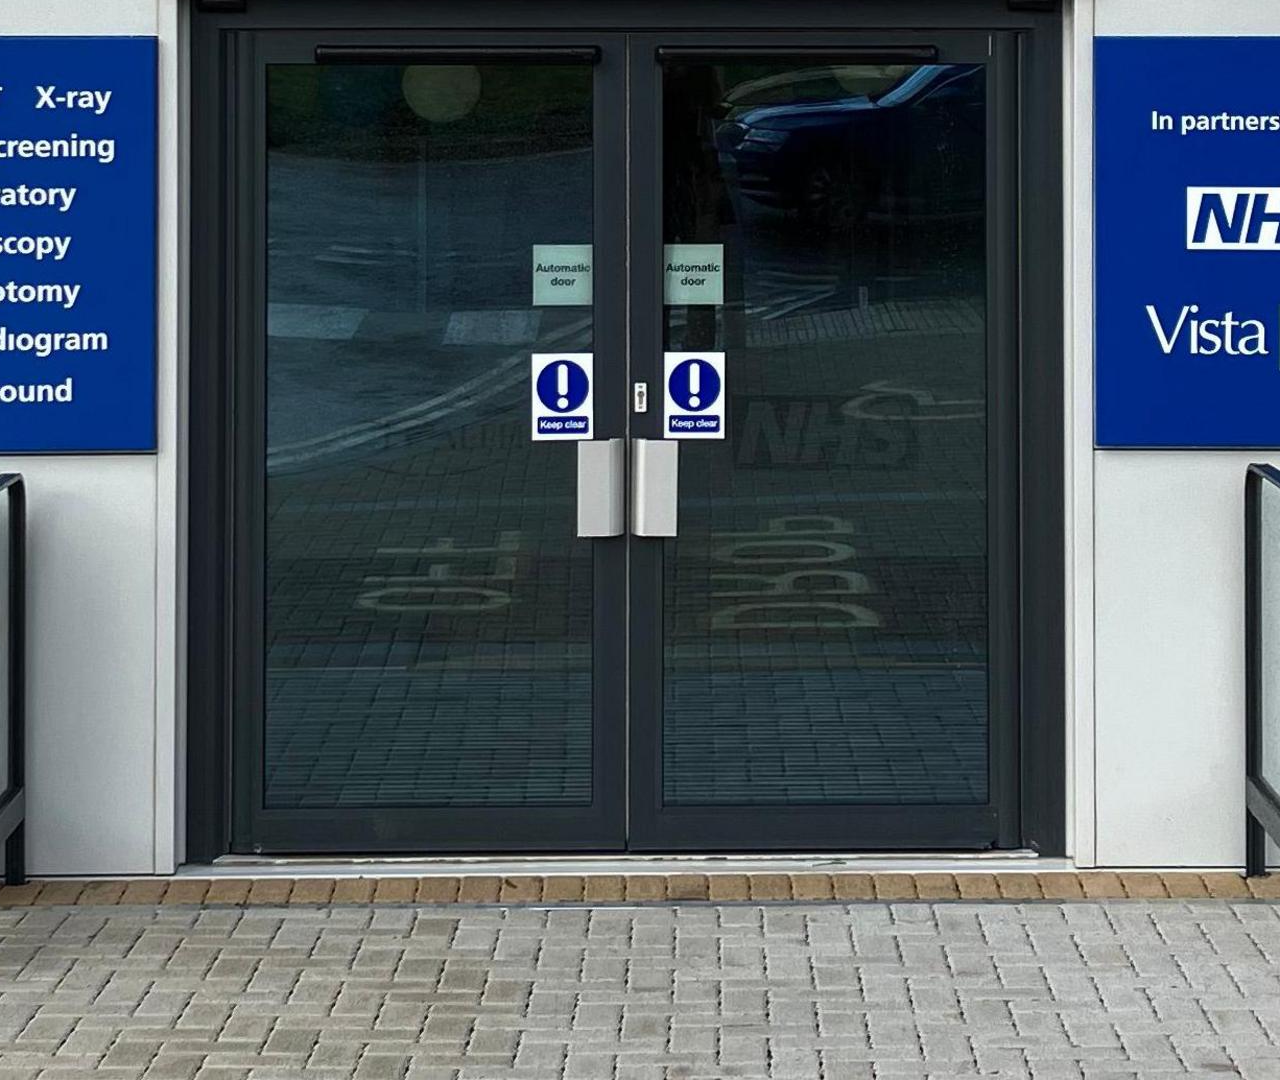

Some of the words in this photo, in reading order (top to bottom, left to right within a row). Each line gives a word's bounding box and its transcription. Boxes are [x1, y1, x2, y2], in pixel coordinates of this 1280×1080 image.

[35, 85, 112, 115] X-ray
[1151, 110, 1173, 130] In
[535, 263, 592, 273] Automatic
[665, 263, 721, 273] Automatic
[550, 276, 577, 287] door
[680, 276, 707, 287] door
[1145, 304, 1269, 355] Vista
[539, 419, 564, 430] Keep
[564, 420, 587, 429] clear
[671, 418, 695, 429] Keep
[695, 419, 718, 428] clear
